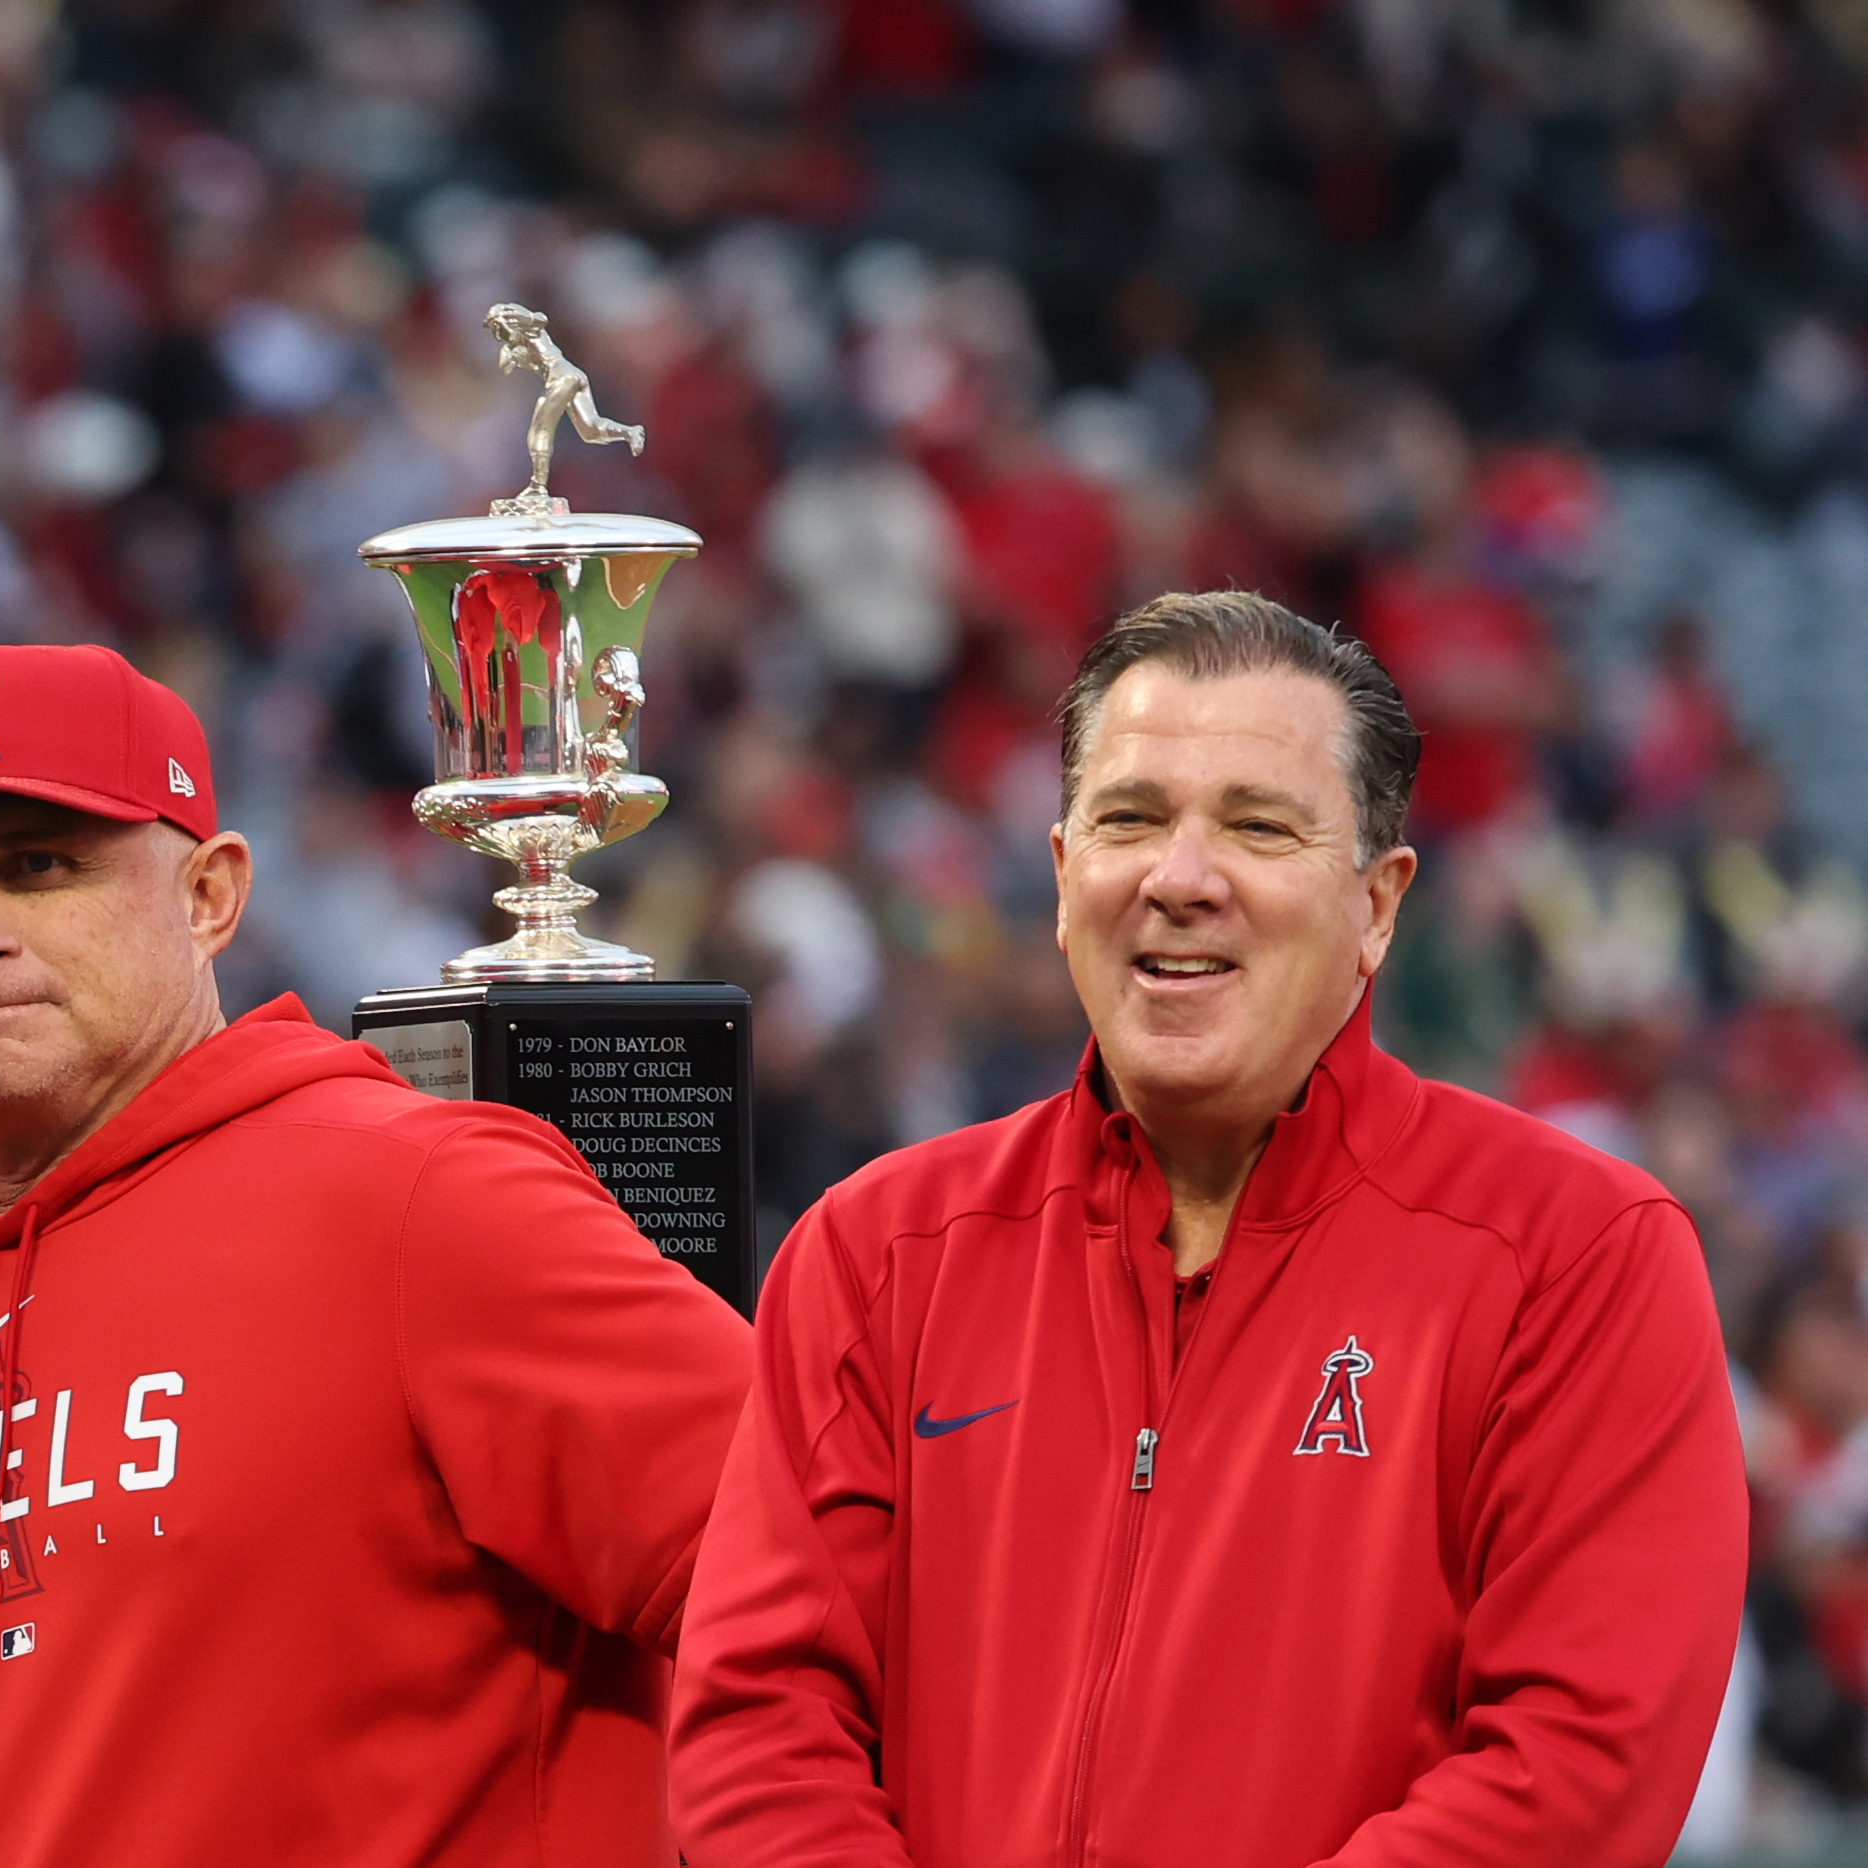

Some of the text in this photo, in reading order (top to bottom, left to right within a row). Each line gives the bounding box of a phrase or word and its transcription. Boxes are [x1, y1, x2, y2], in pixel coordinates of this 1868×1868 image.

[518, 1037, 552, 1053] 1979
[569, 1037, 611, 1053] DON
[614, 1037, 687, 1053] BAYLOR
[518, 1062, 552, 1078] 1980
[570, 1062, 629, 1078] BOBBY
[633, 1062, 692, 1078] GRICH
[570, 1087, 733, 1103] JASON THOMPSON
[571, 1112, 615, 1128] RICK
[619, 1112, 715, 1128] BURLESON
[571, 1137, 721, 1153] DOUG DECINCES
[612, 1162, 675, 1178] BOONE
[623, 1187, 716, 1206] BENIQUEZ
[635, 1212, 726, 1228] DOWNING
[651, 1237, 717, 1253] MOORE
[1292, 1334, 1375, 1457] A
